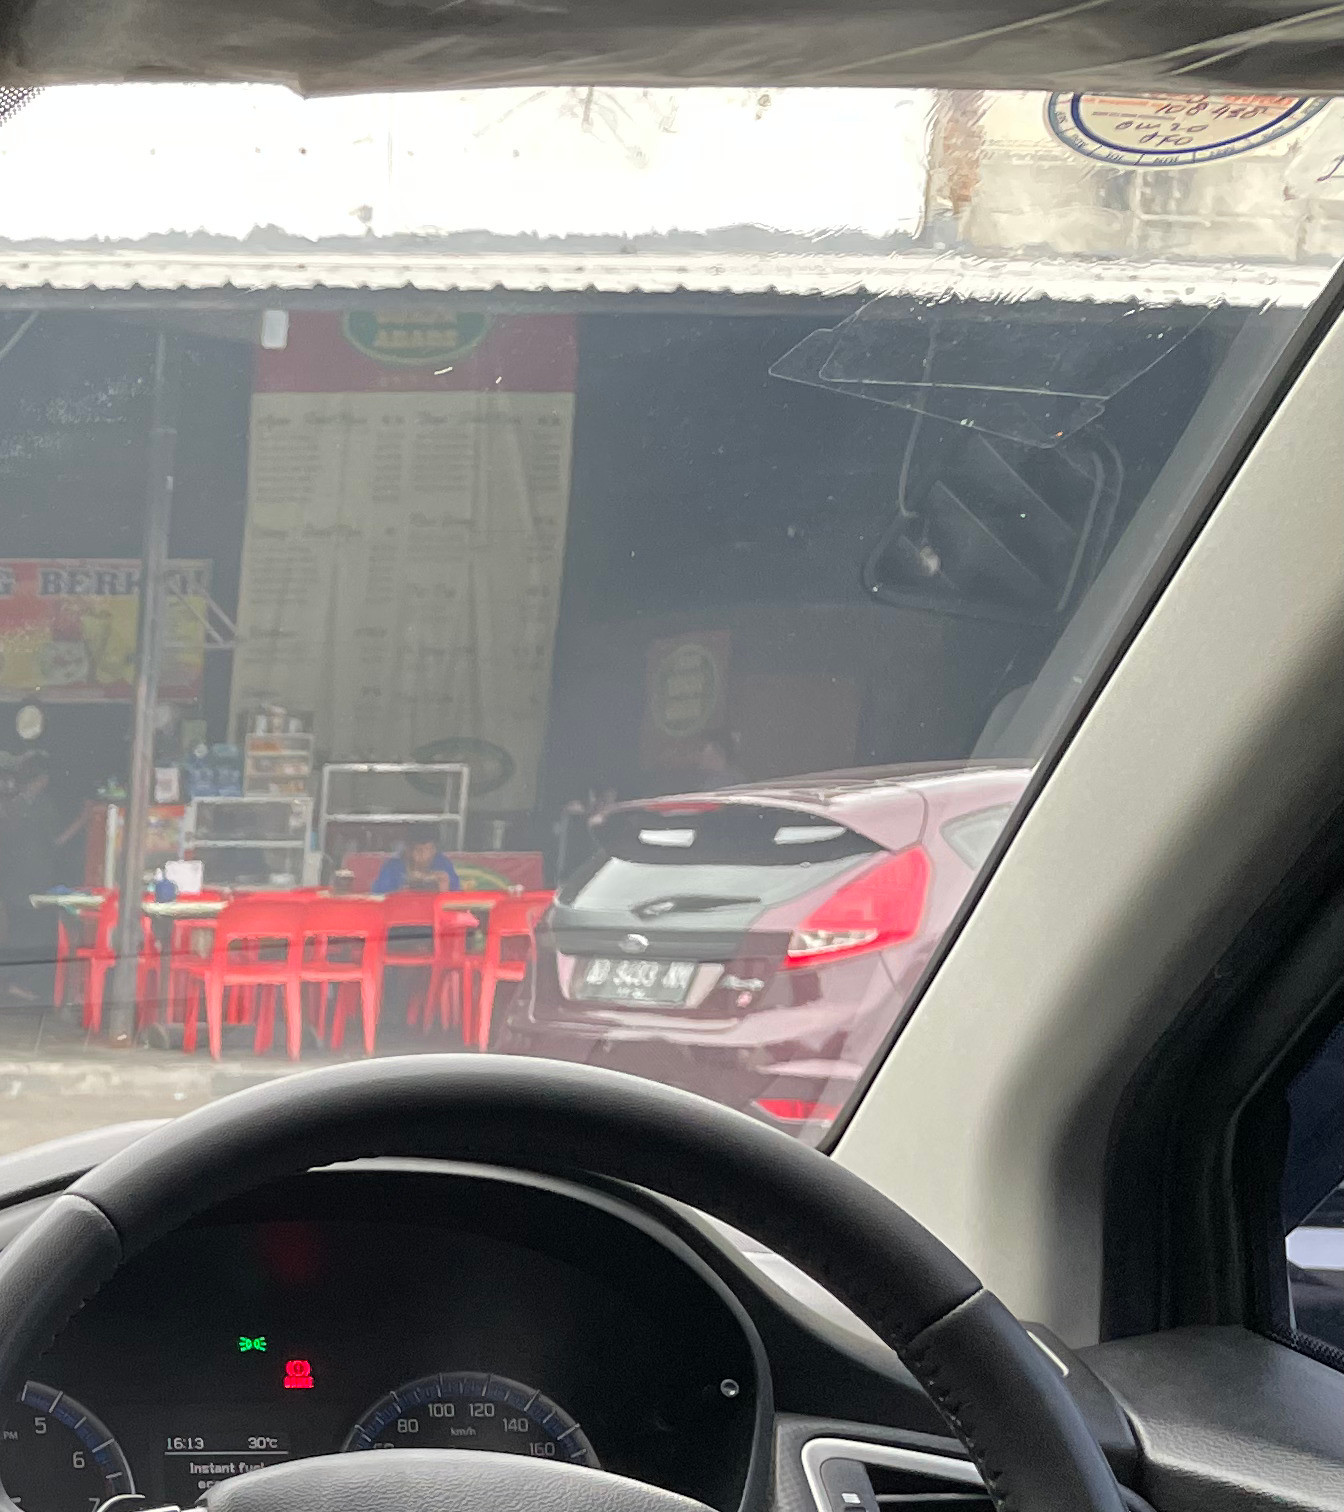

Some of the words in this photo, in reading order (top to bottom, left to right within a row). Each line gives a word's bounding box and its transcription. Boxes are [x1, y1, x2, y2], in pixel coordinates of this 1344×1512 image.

[428, 1403, 455, 1418] 100
[469, 1403, 495, 1418] 120
[34, 1417, 47, 1435] 5
[397, 1418, 419, 1434] 80
[450, 1425, 476, 1437] km/h
[503, 1417, 529, 1432] 140
[166, 1436, 205, 1450] 16:13
[530, 1442, 555, 1457] 160
[72, 1451, 85, 1469] 6
[189, 1461, 235, 1474] Instant
